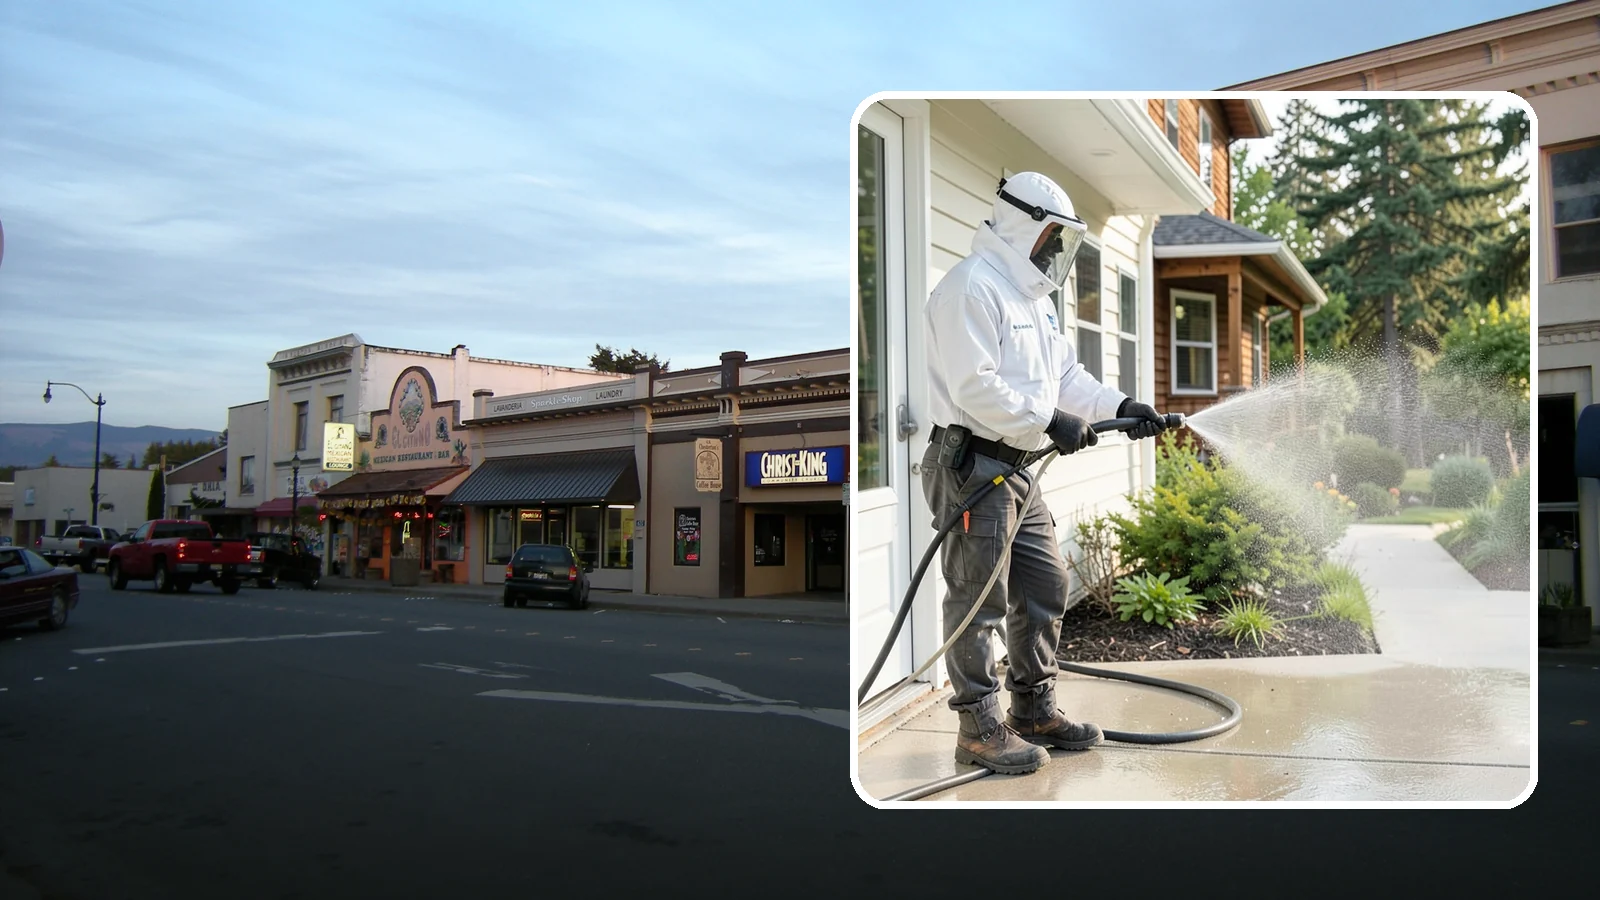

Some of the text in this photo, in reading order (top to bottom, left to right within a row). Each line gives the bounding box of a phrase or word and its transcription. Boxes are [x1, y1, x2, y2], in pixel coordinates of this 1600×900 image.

[562, 394, 582, 405] Shop
[595, 389, 624, 400] LAUNDRY
[493, 402, 522, 412] LAVANDERIA
[397, 451, 434, 463] RESTAURANT
[437, 450, 450, 459] BAR
[760, 450, 827, 478] CHRIST KING
[696, 480, 709, 489] Coffee
